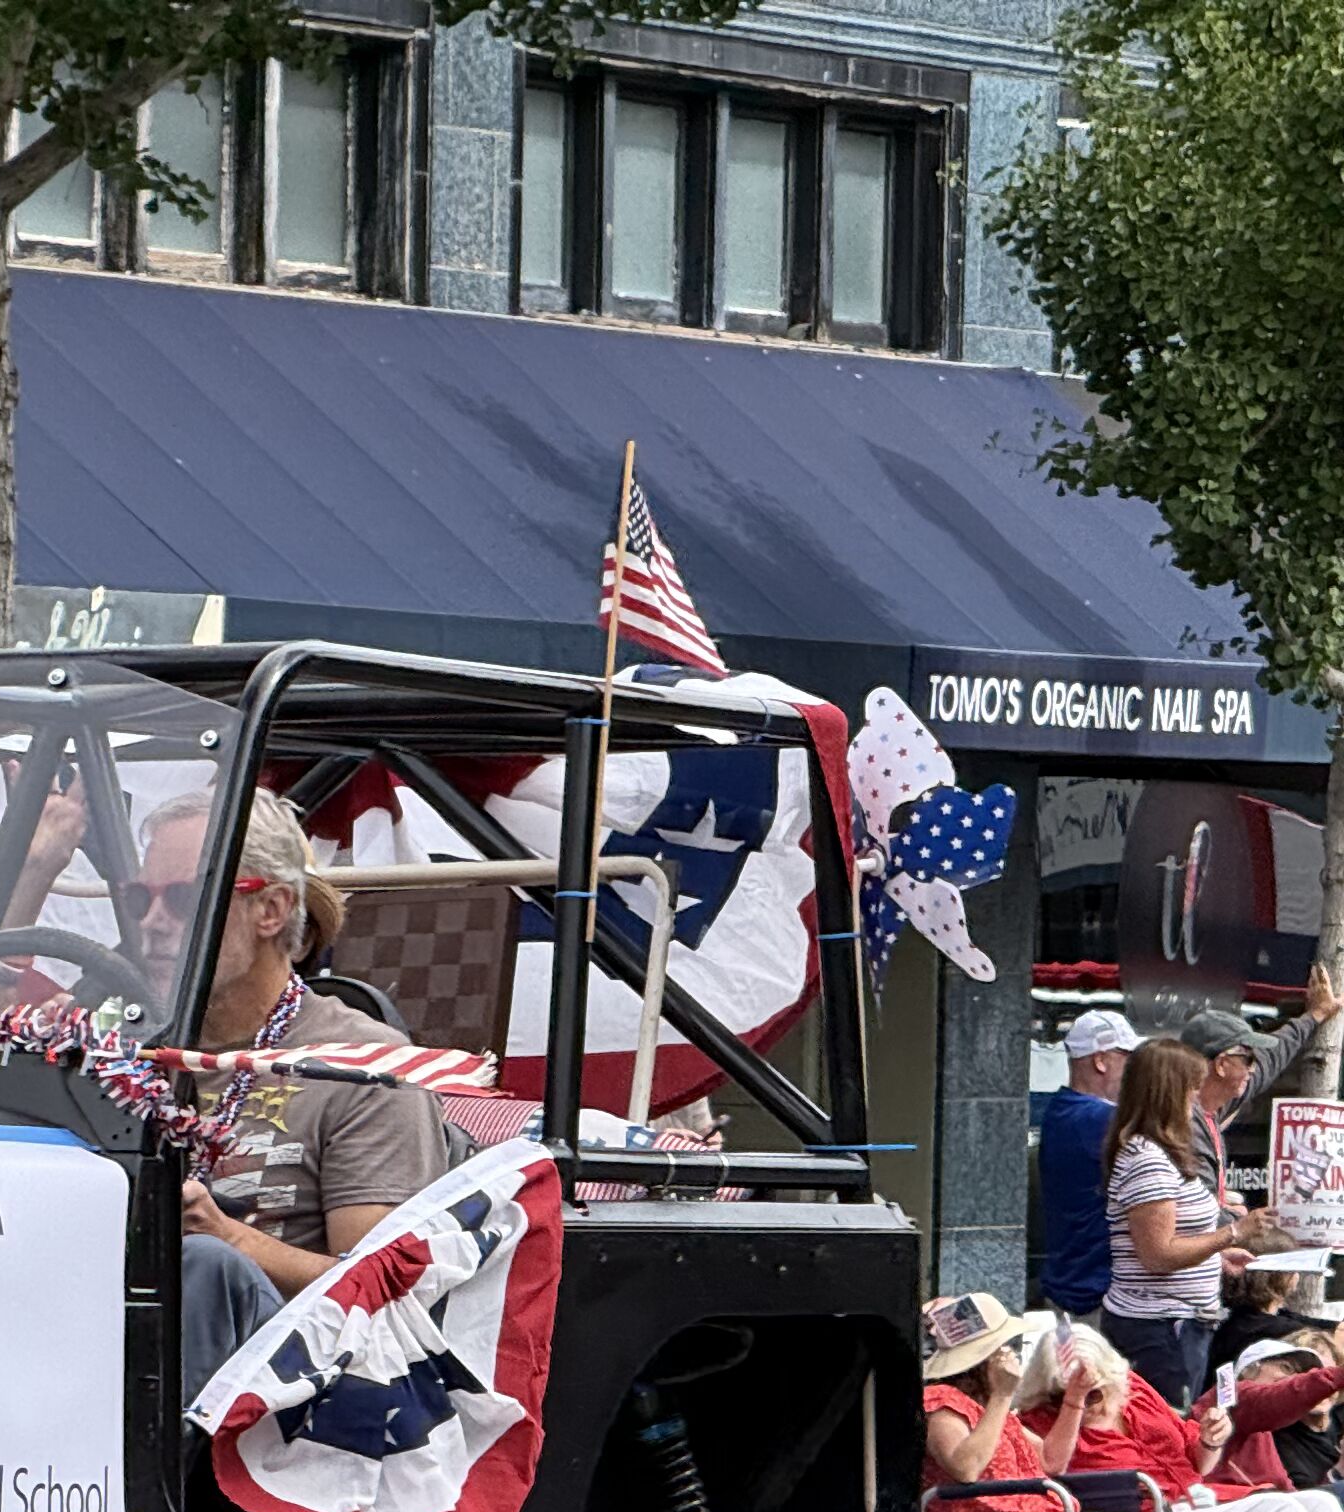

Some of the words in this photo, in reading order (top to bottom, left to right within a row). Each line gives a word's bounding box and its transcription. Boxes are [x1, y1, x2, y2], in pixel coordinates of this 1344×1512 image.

[929, 674, 1022, 724] TOMO'S
[1031, 680, 1143, 731] ORGANIC
[1151, 687, 1203, 733] NAIL
[1212, 688, 1252, 735] SPA
